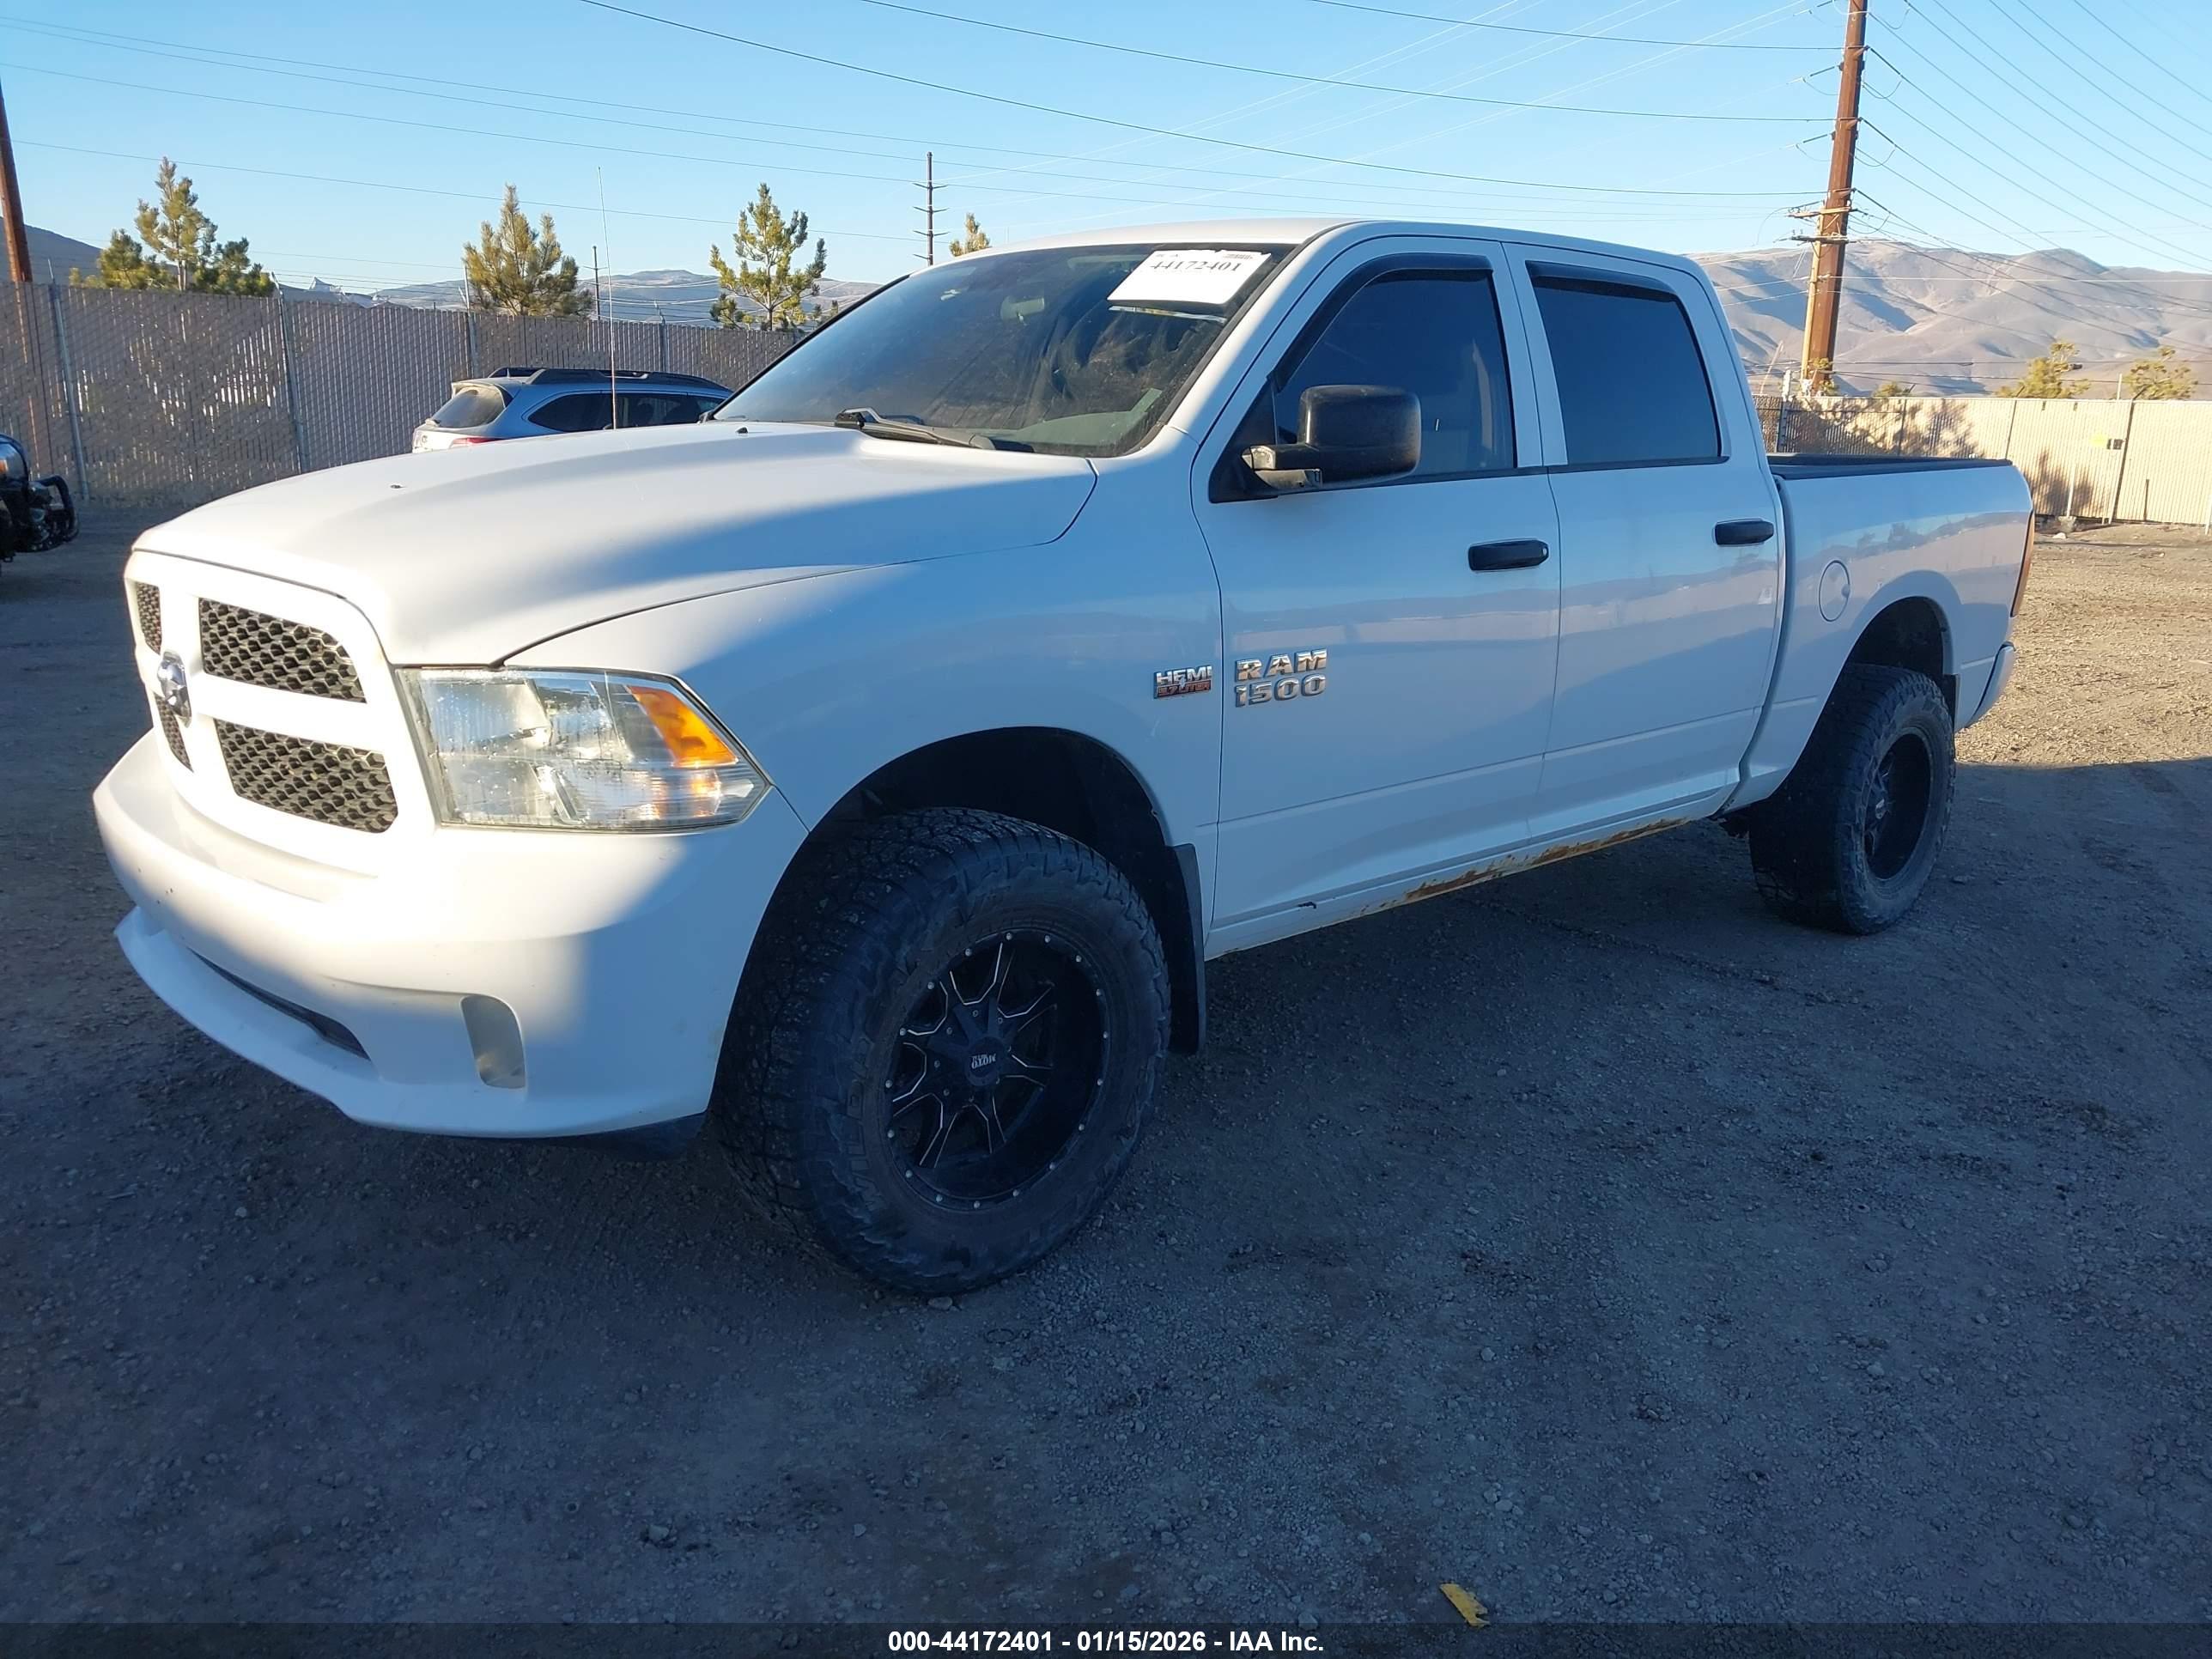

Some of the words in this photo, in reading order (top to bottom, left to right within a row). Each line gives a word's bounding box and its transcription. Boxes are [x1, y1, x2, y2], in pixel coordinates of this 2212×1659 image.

[1150, 260, 1242, 272] 44172401
[1156, 665, 1212, 685] HEMI
[1235, 648, 1328, 682] RAM
[1235, 674, 1328, 708] 1500
